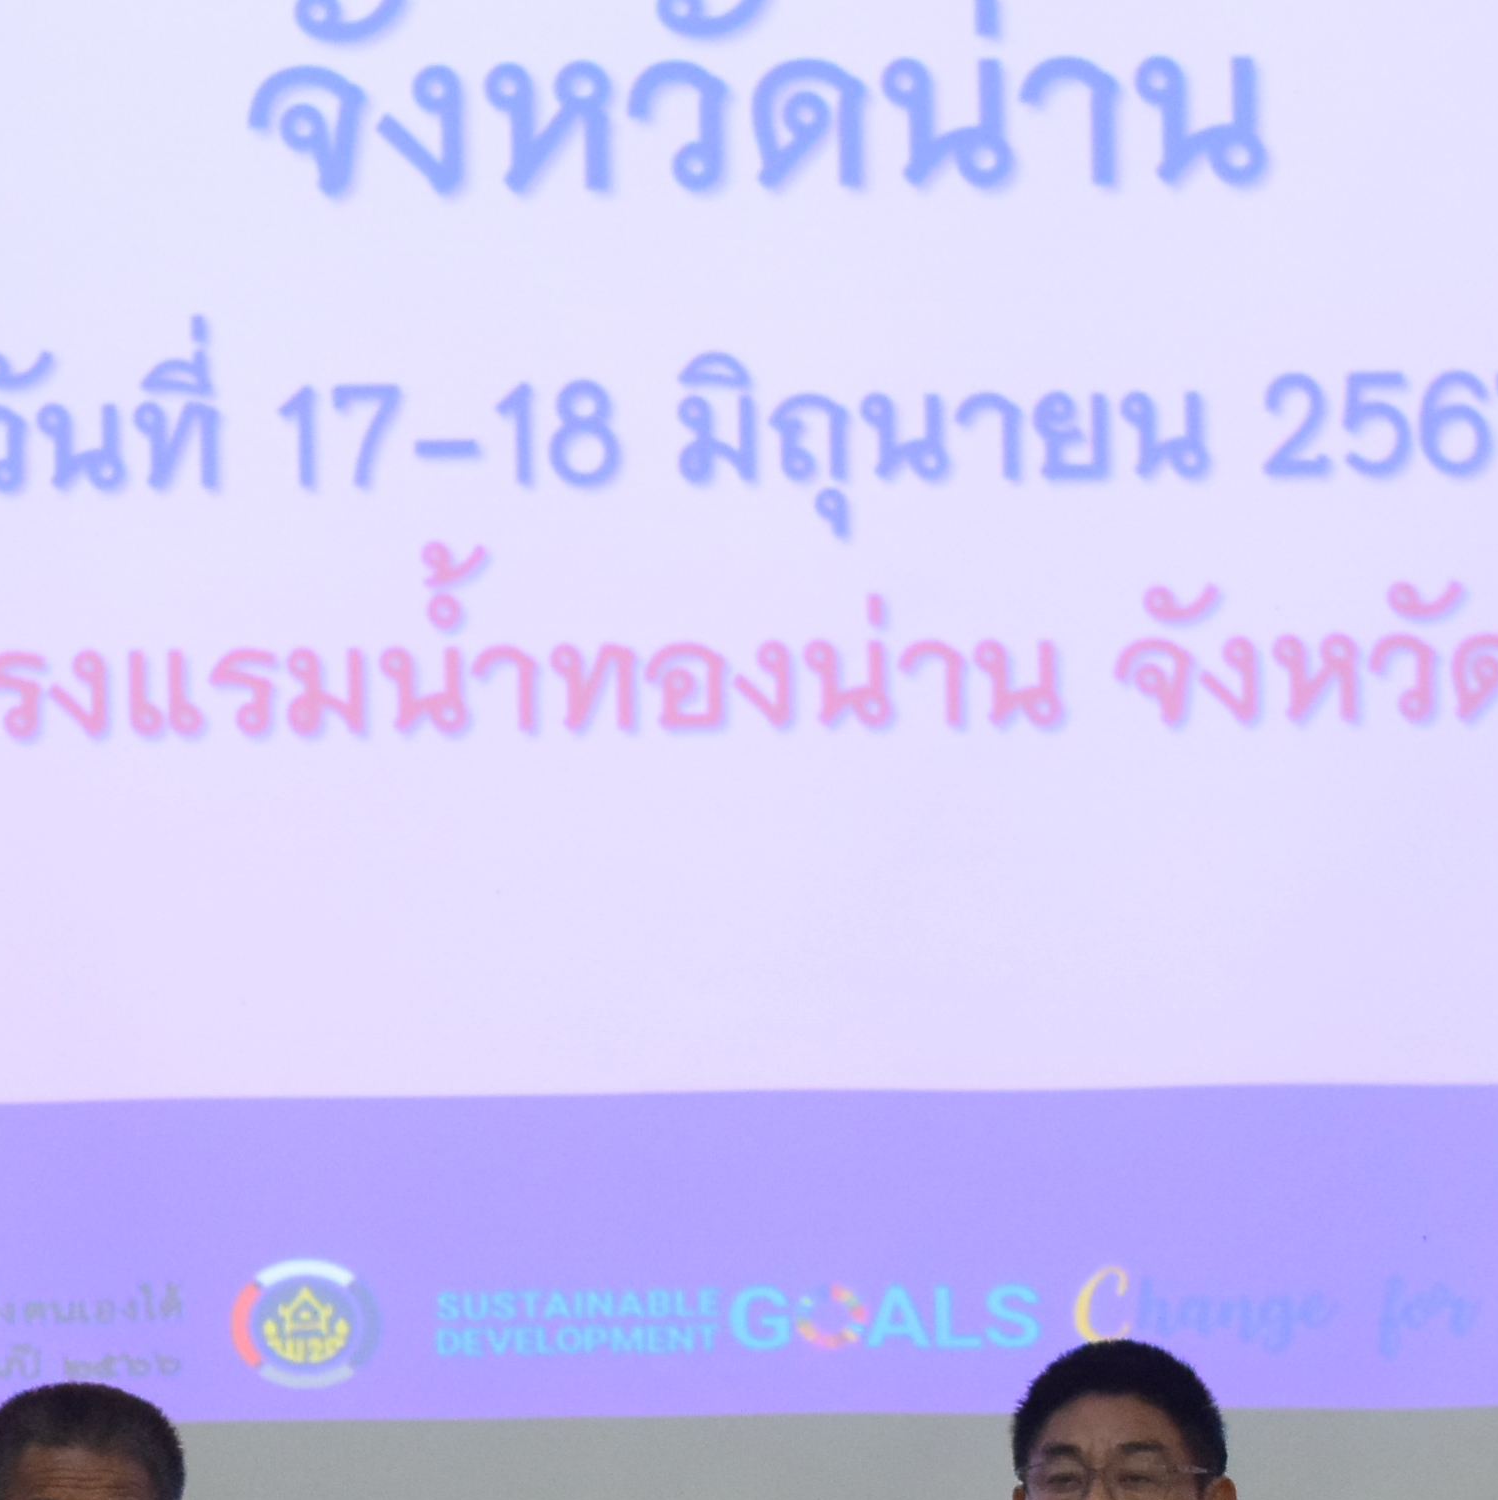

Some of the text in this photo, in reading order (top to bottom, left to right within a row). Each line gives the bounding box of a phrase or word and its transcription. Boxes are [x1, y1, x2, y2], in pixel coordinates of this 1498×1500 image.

[248, 0, 1269, 199] จังหวัดน่าน
[278, 379, 624, 491] 17-18
[678, 351, 1212, 541] มิถุนายน
[435, 1288, 720, 1321] SUSTAINABLE
[728, 1281, 1042, 1352] GOALS
[435, 1324, 719, 1357] DEVELOPMENT
